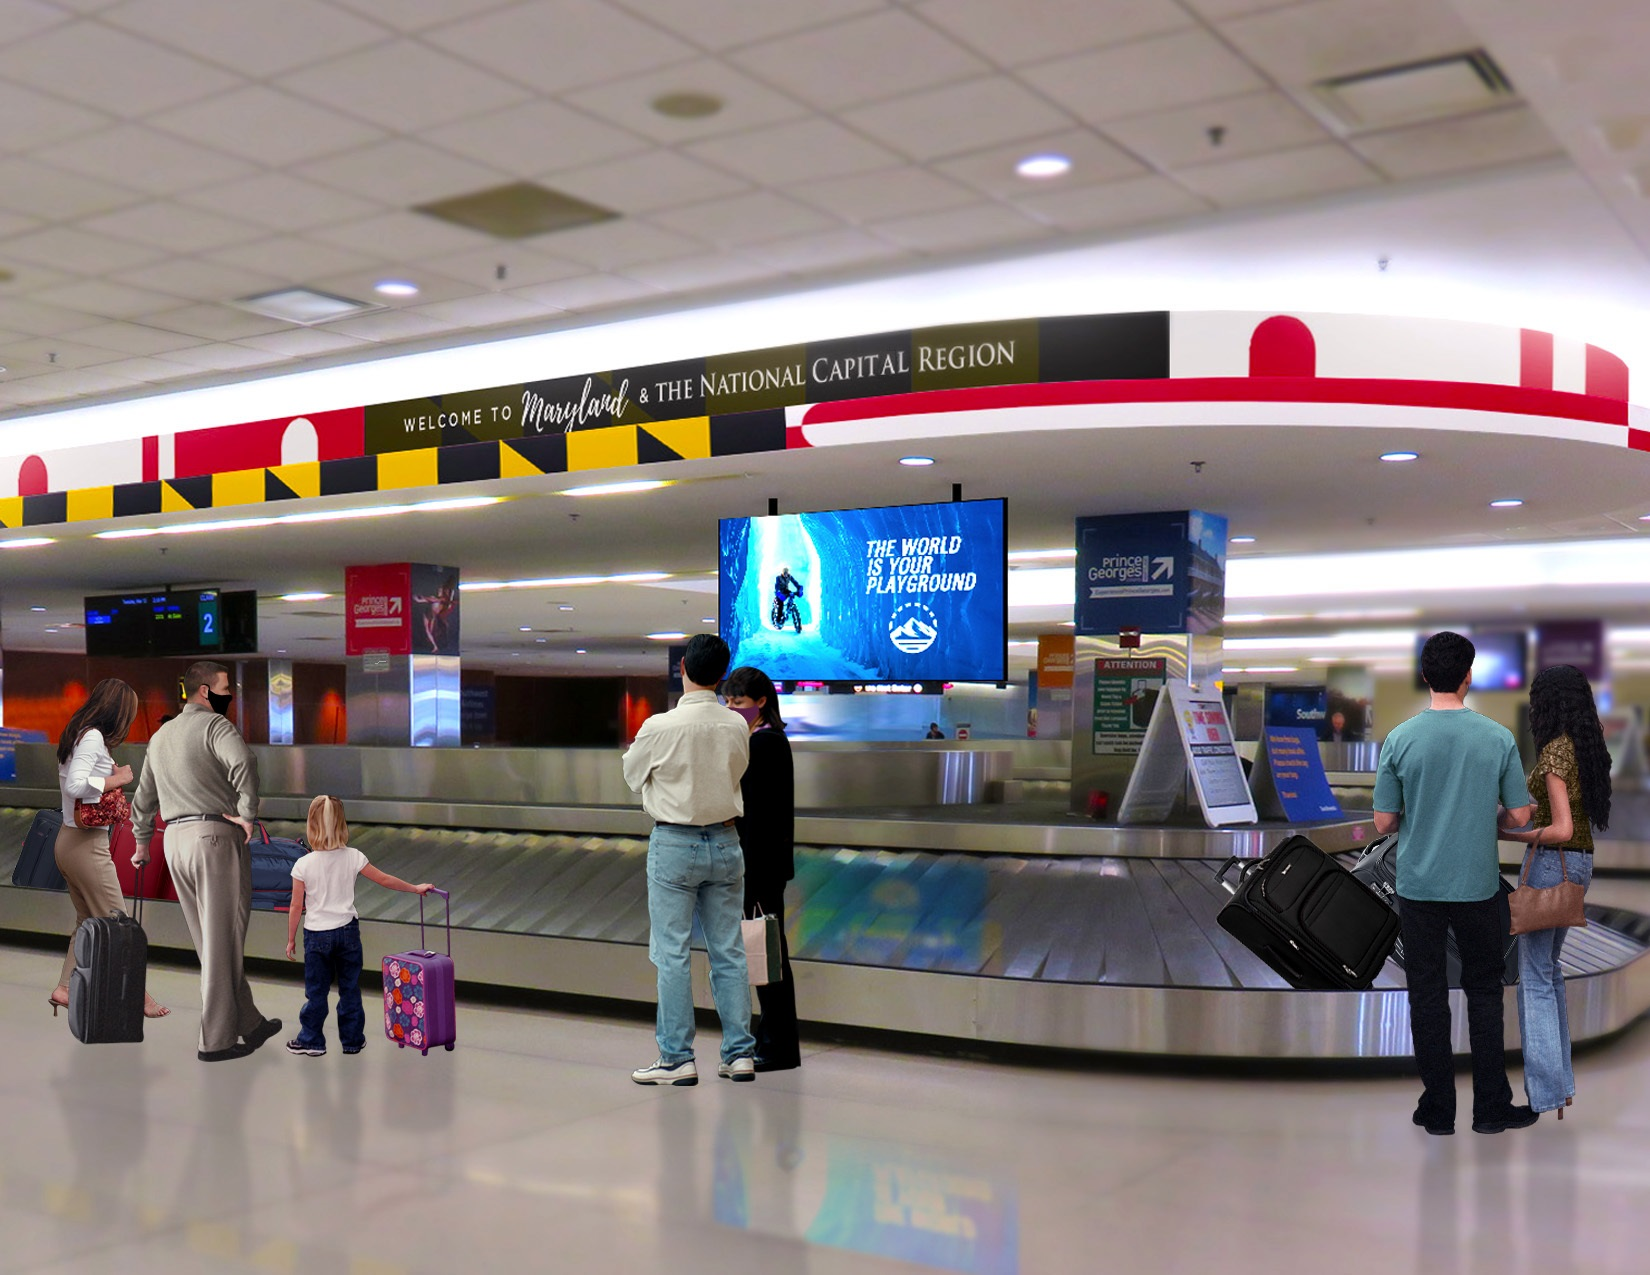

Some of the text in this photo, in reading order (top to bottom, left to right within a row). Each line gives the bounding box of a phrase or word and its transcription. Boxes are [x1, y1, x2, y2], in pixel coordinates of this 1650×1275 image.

[404, 341, 1016, 433] WELCOME TO Maryland & THE NATIONAL CAPITAL REGION
[866, 535, 962, 558] THE WORLD
[866, 555, 934, 577] IS YOUR
[865, 572, 978, 595] PLAYGROUND
[203, 613, 214, 633] 2
[1103, 661, 1157, 669] ATTENTION
